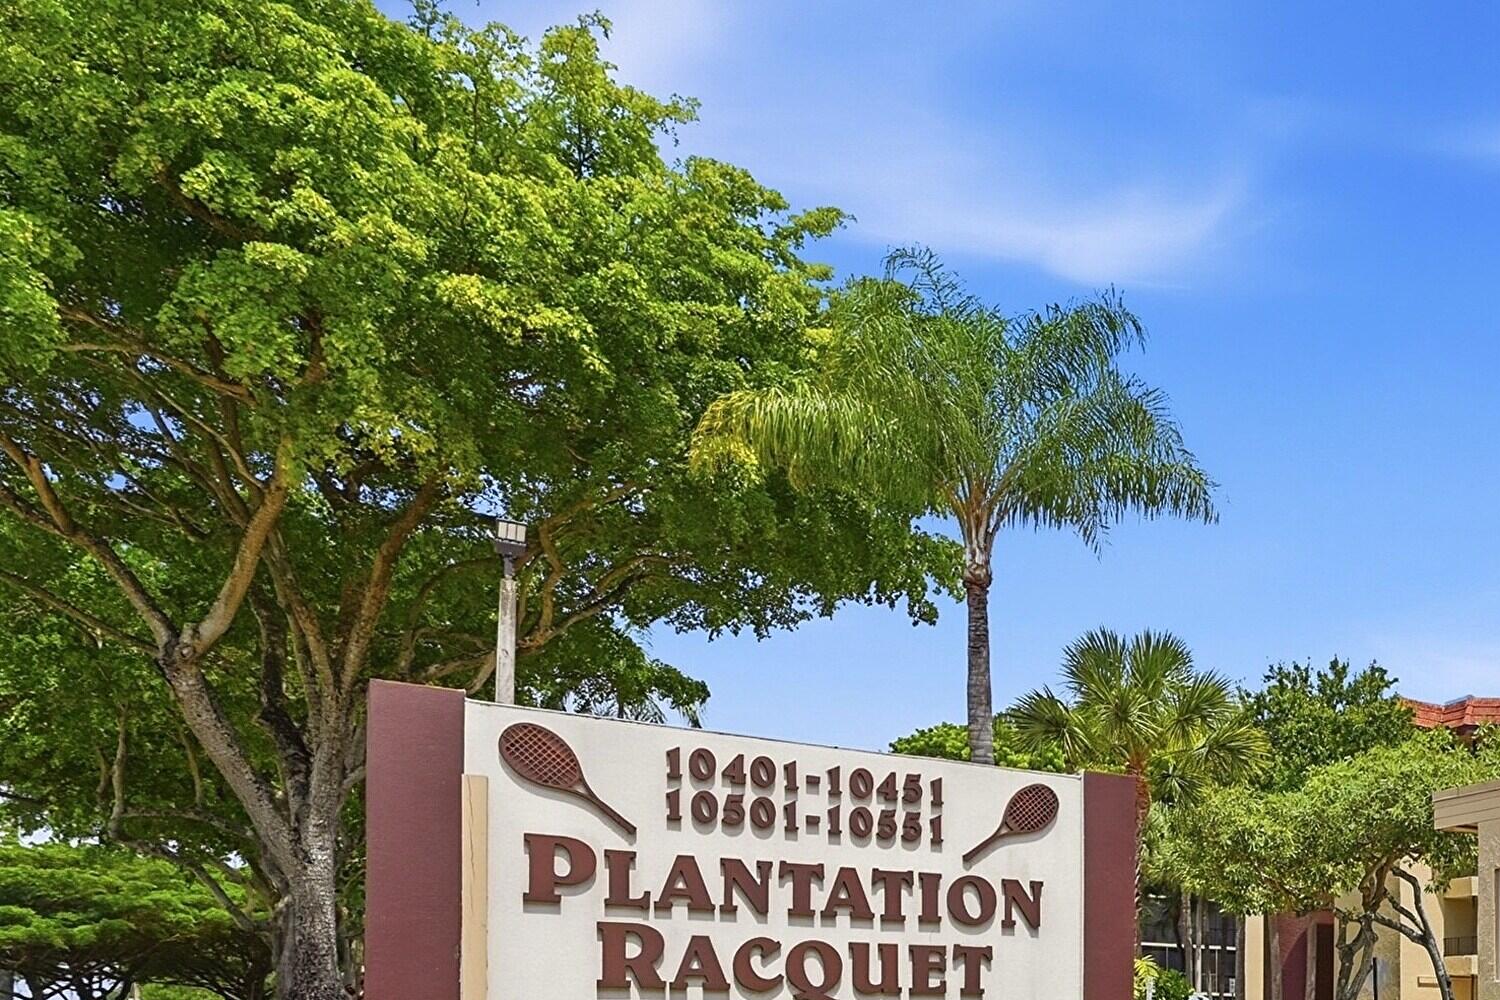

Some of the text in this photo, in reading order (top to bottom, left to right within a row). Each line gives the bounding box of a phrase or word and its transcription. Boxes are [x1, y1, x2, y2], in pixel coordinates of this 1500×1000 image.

[666, 747, 944, 806] 10401-10451
[666, 789, 943, 844] 10501-10551
[523, 832, 1044, 931] PLANTATION
